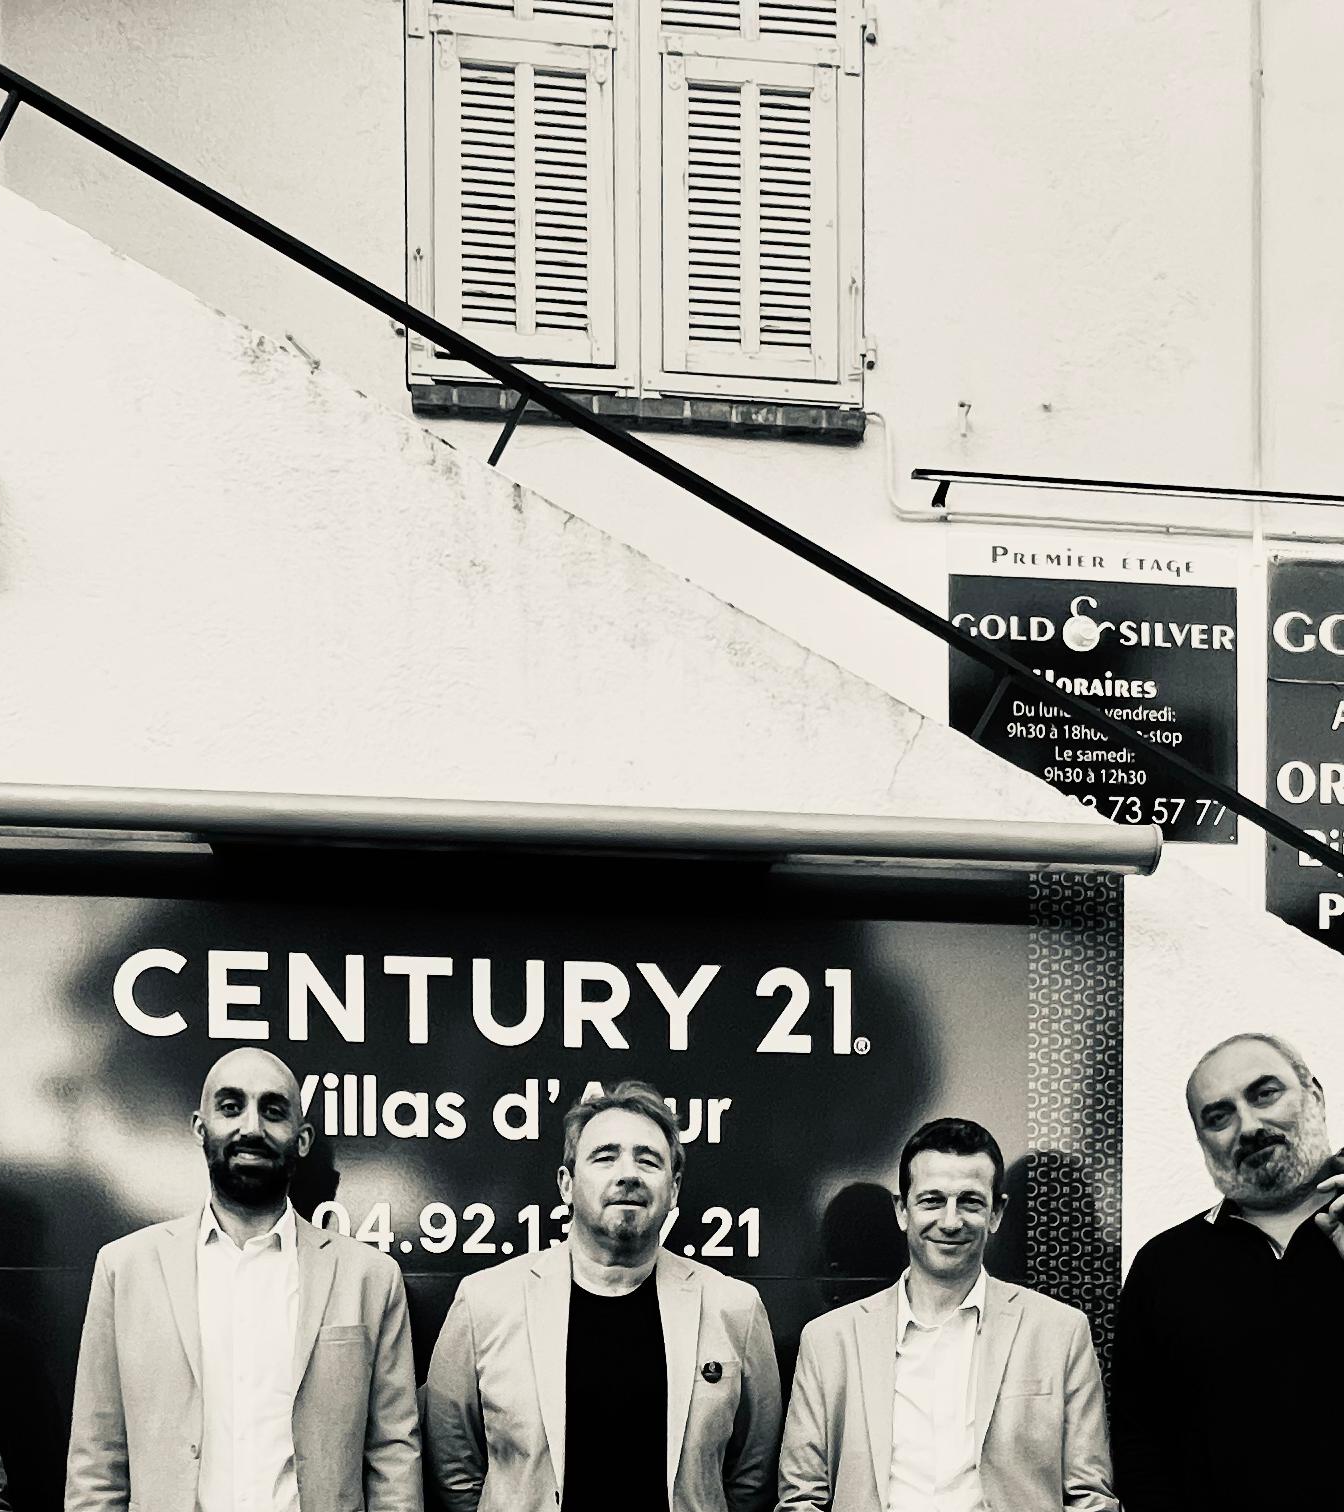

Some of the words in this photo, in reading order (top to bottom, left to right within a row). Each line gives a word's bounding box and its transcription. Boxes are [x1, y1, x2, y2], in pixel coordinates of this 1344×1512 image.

[1119, 621, 1235, 651] SILVER
[1013, 700, 1035, 717] Du
[1104, 705, 1177, 723] vendredi:
[1006, 722, 1046, 739] 9h30
[1049, 723, 1058, 739] à
[1054, 745, 1072, 761] Le
[1076, 746, 1136, 764] samedi:
[1044, 766, 1083, 783] 9h30
[1086, 767, 1095, 784] à
[1100, 768, 1147, 785] 12h30
[1108, 796, 1143, 824] 73
[1151, 798, 1186, 825] 57
[112, 945, 721, 1052] CENTURY
